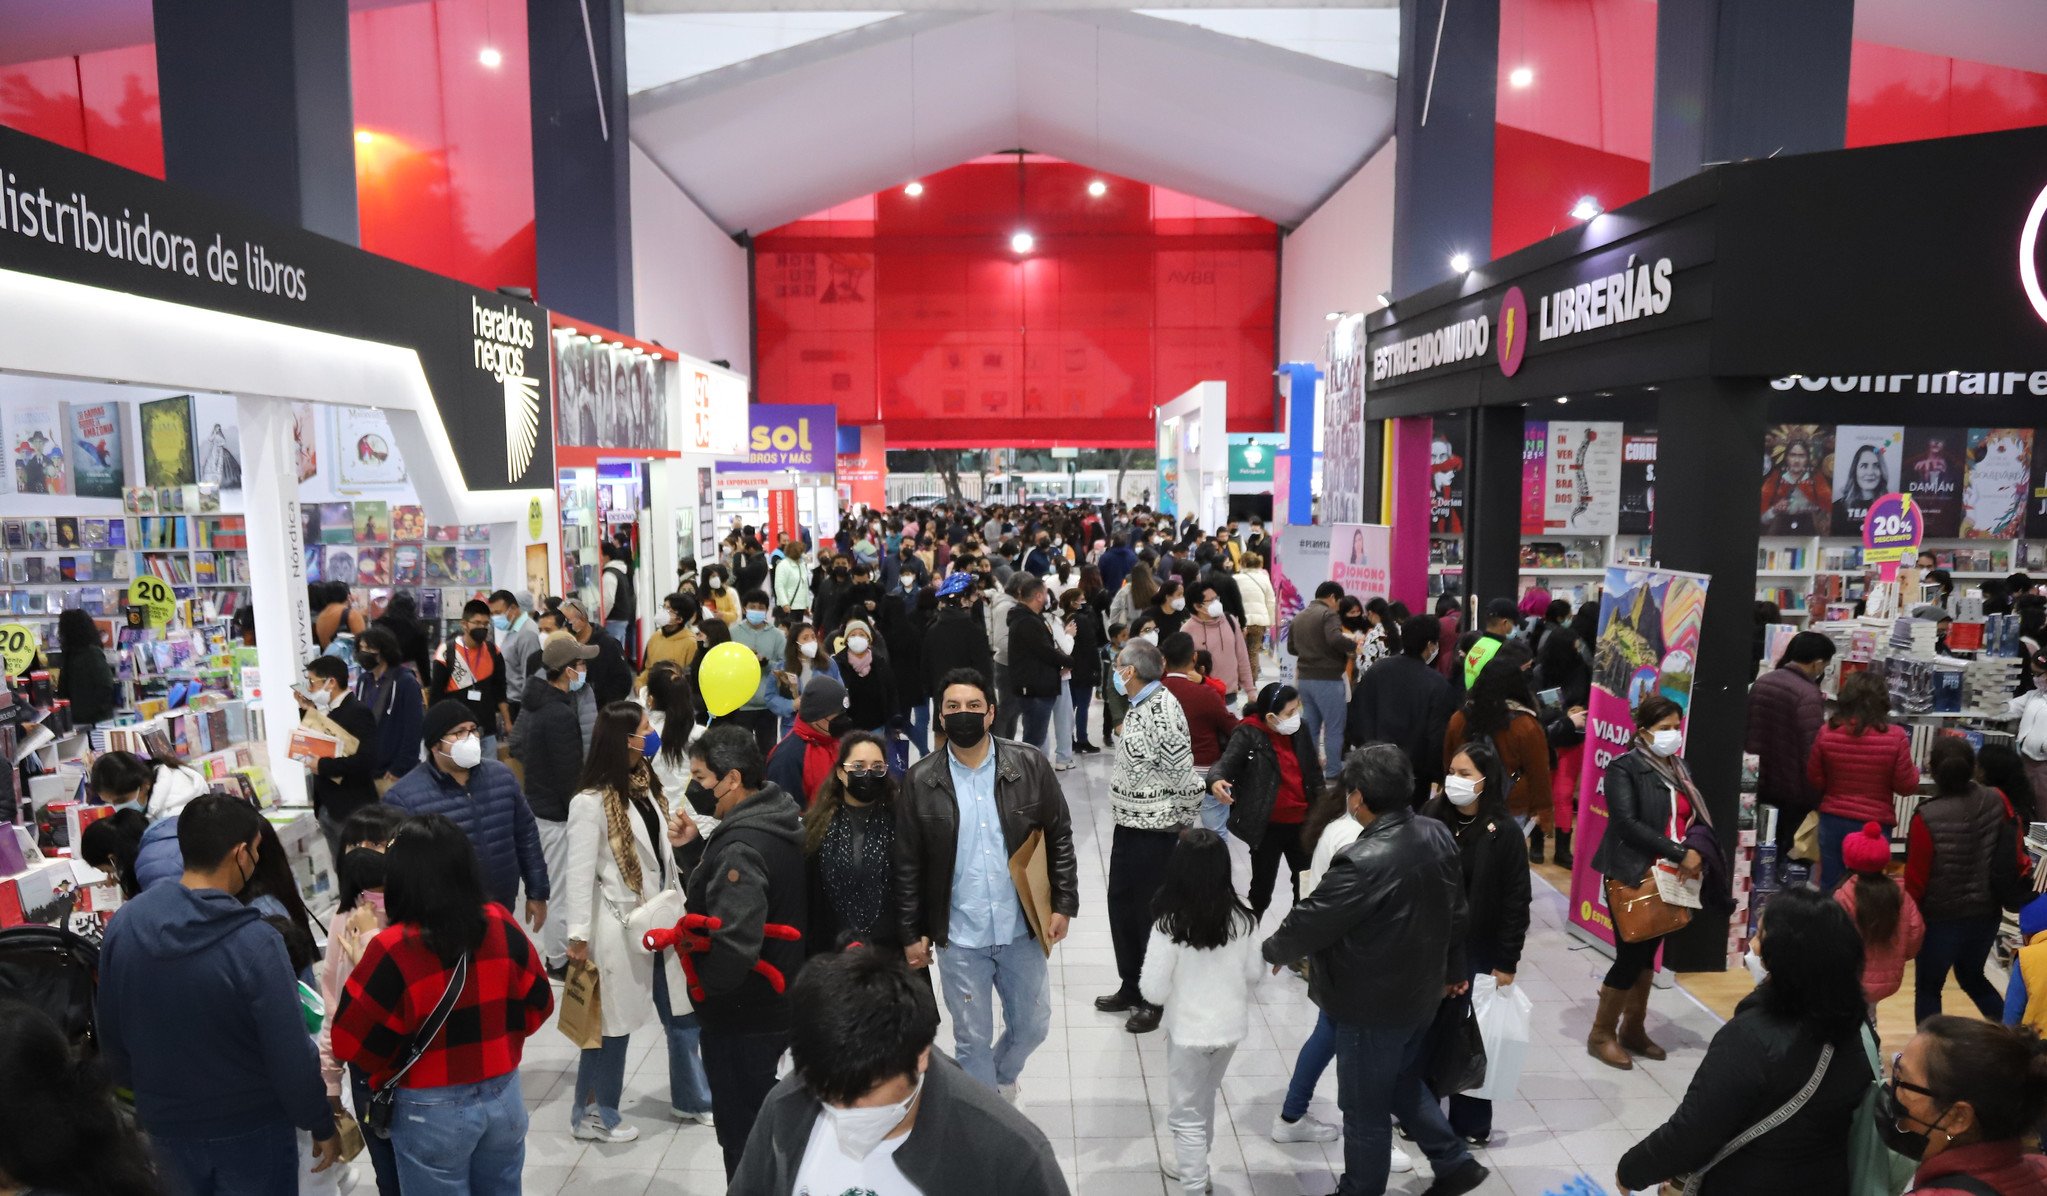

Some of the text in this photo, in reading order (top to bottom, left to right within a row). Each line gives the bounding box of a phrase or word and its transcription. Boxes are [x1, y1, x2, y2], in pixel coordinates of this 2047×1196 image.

[207, 233, 239, 286] de
[245, 241, 308, 302] libros
[472, 294, 534, 349] heraldos
[1373, 253, 1673, 382] ESTRUENDOMUDO LIBRERÍAS
[474, 338, 525, 383] negros
[780, 452, 788, 464] Y
[789, 450, 812, 464] MÁS
[1909, 480, 1955, 494] DAMIÁN
[1873, 515, 1912, 537] 20%
[287, 501, 311, 679] delvives Nórdica
[1592, 718, 1632, 746] VIAJA
